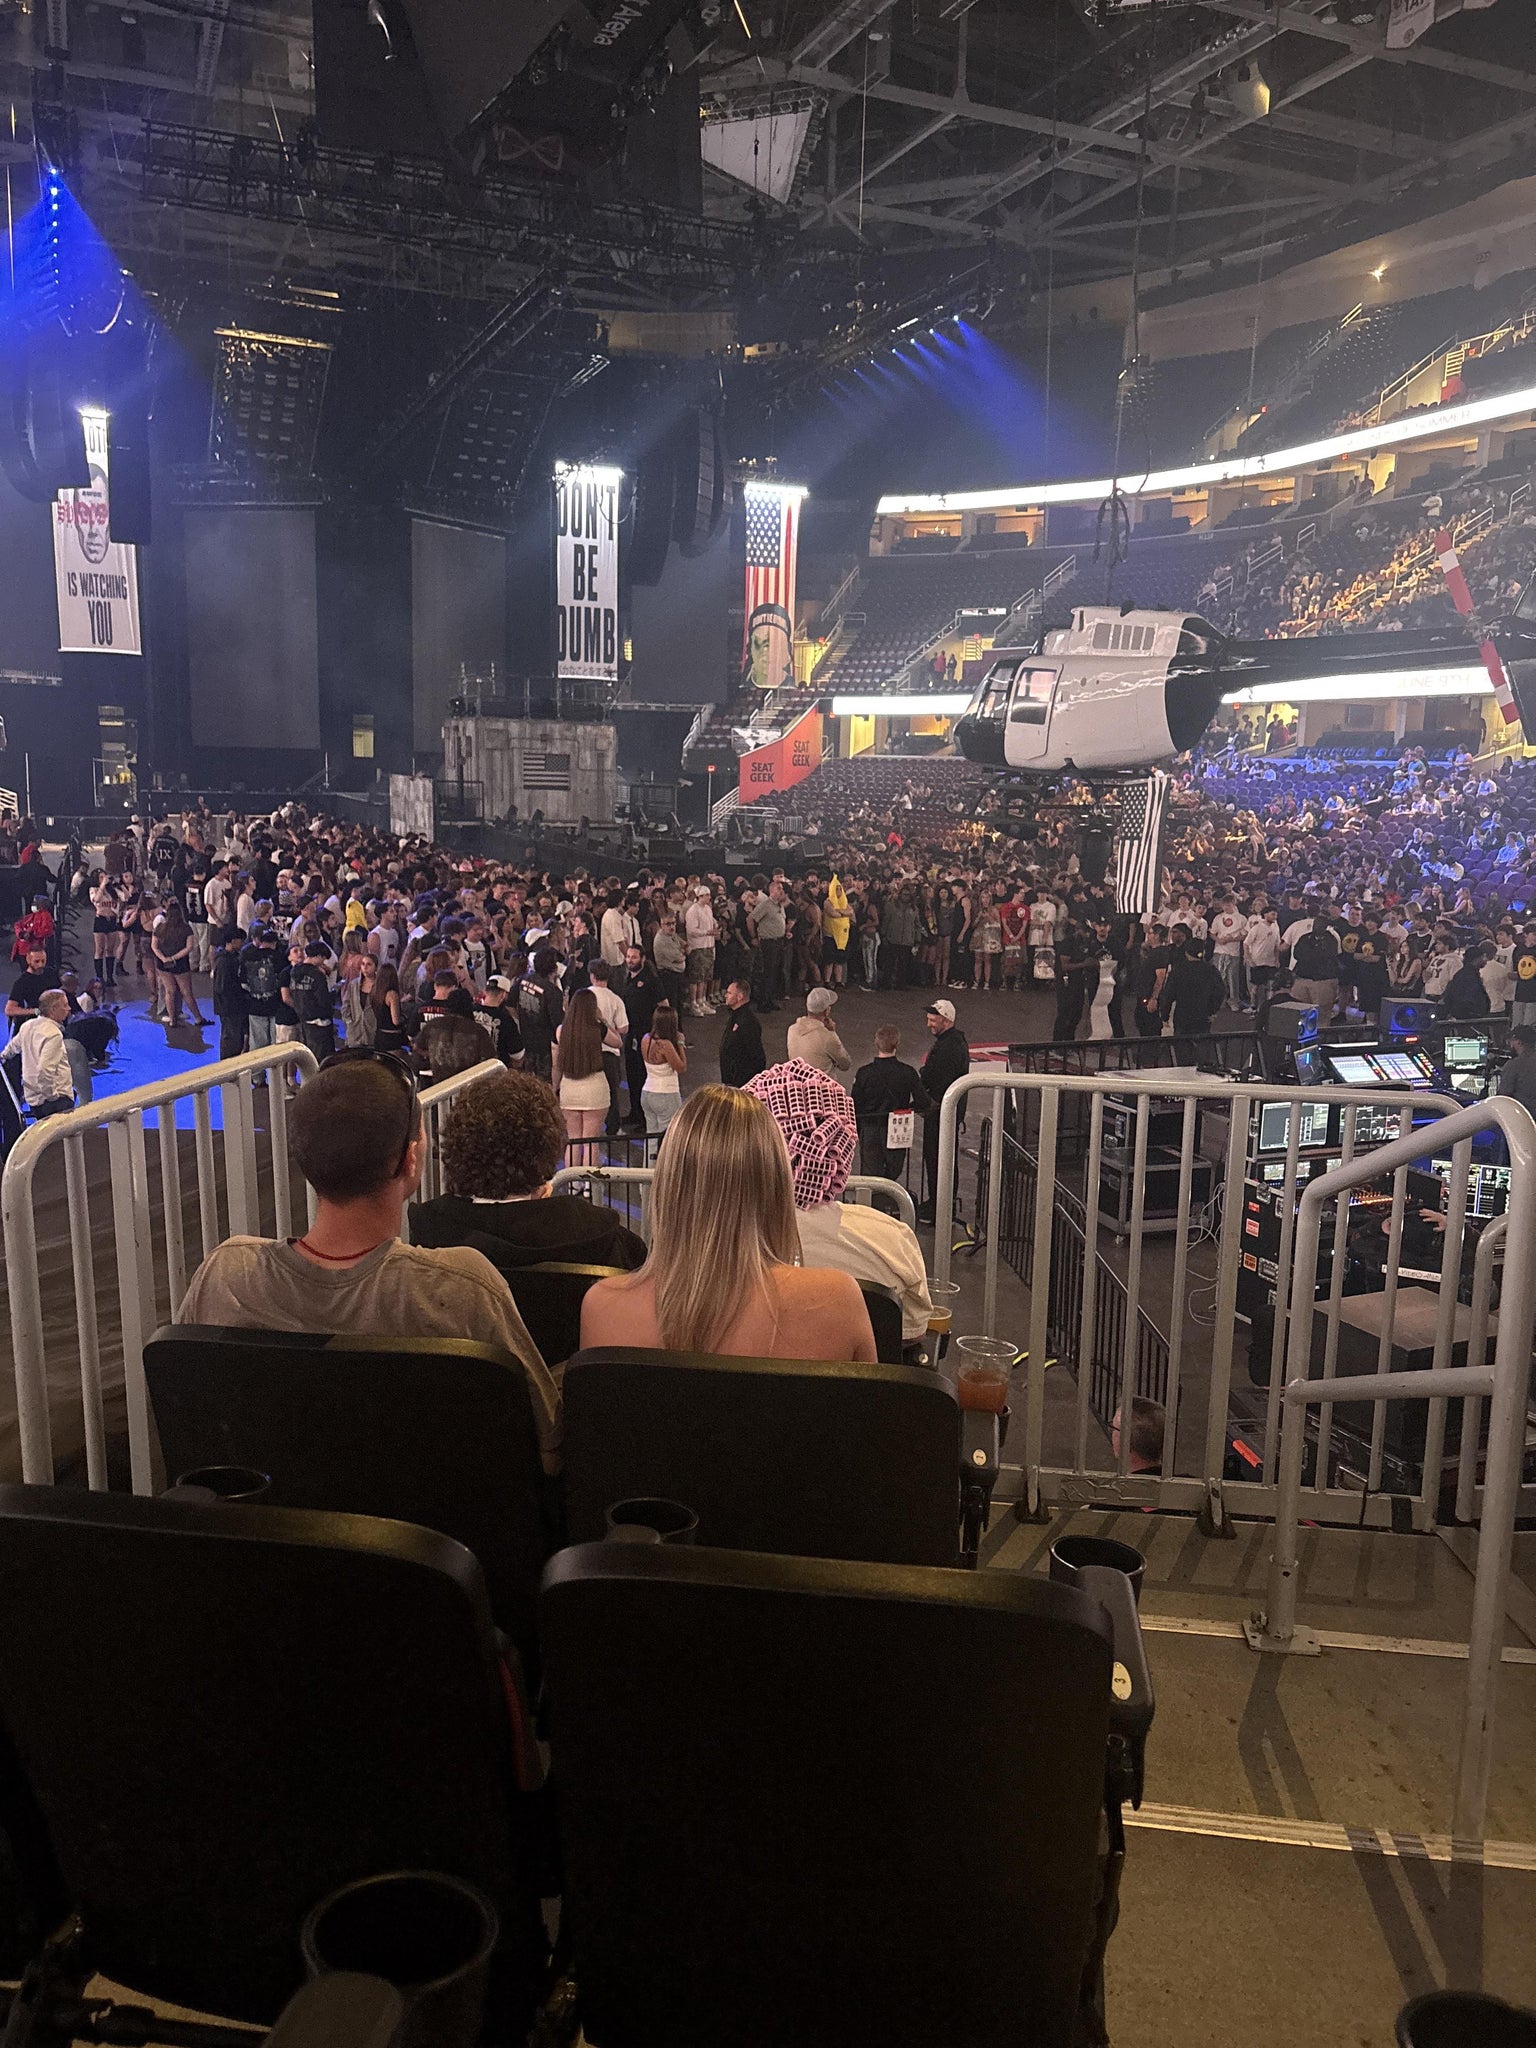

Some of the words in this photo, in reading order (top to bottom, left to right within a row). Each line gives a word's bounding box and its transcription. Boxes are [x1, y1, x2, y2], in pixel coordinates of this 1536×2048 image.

[593, 4, 642, 45] Arena
[67, 572, 78, 597] IS
[80, 572, 127, 600] WATCHING
[573, 543, 598, 602] BE
[88, 600, 113, 646] YOU
[558, 605, 615, 664] DUMB
[792, 754, 810, 767] GEEK
[793, 740, 809, 753] SEAT
[750, 773, 775, 783] GEEK
[751, 762, 774, 772] SEAT
